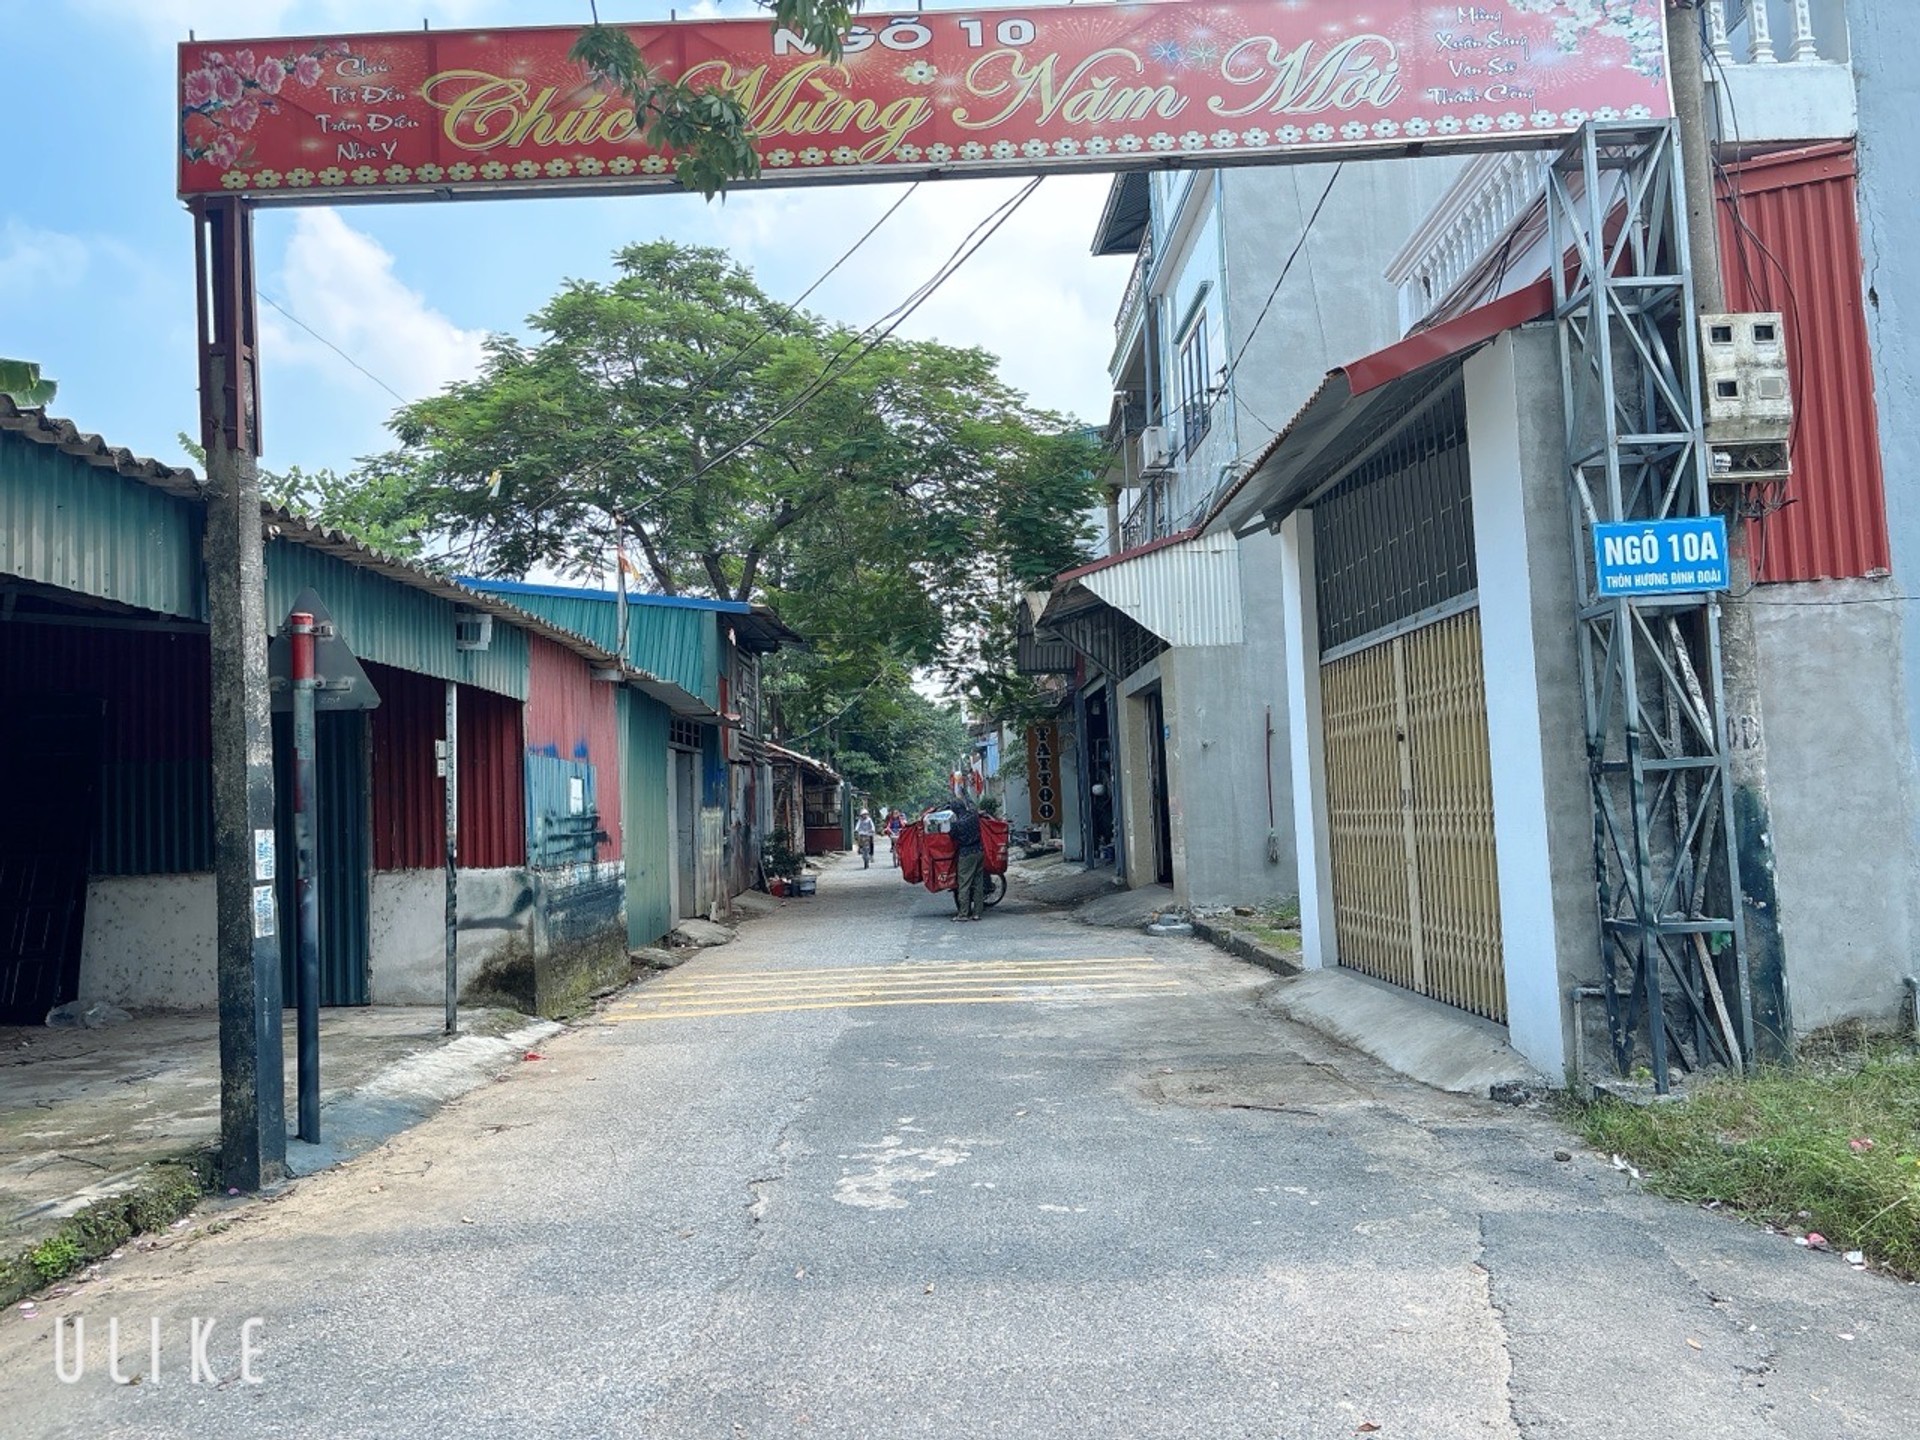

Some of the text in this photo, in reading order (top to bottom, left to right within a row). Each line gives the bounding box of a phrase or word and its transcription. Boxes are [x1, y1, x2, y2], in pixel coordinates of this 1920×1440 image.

[774, 16, 1037, 56] NGÕ 10
[1487, 31, 1529, 60] Sang
[421, 33, 1403, 164] Chúc Mừng Năm Mới
[1604, 529, 1719, 567] NGÕ 10A
[1606, 571, 1632, 588] THÔN
[1034, 726, 1055, 820] TATTOO
